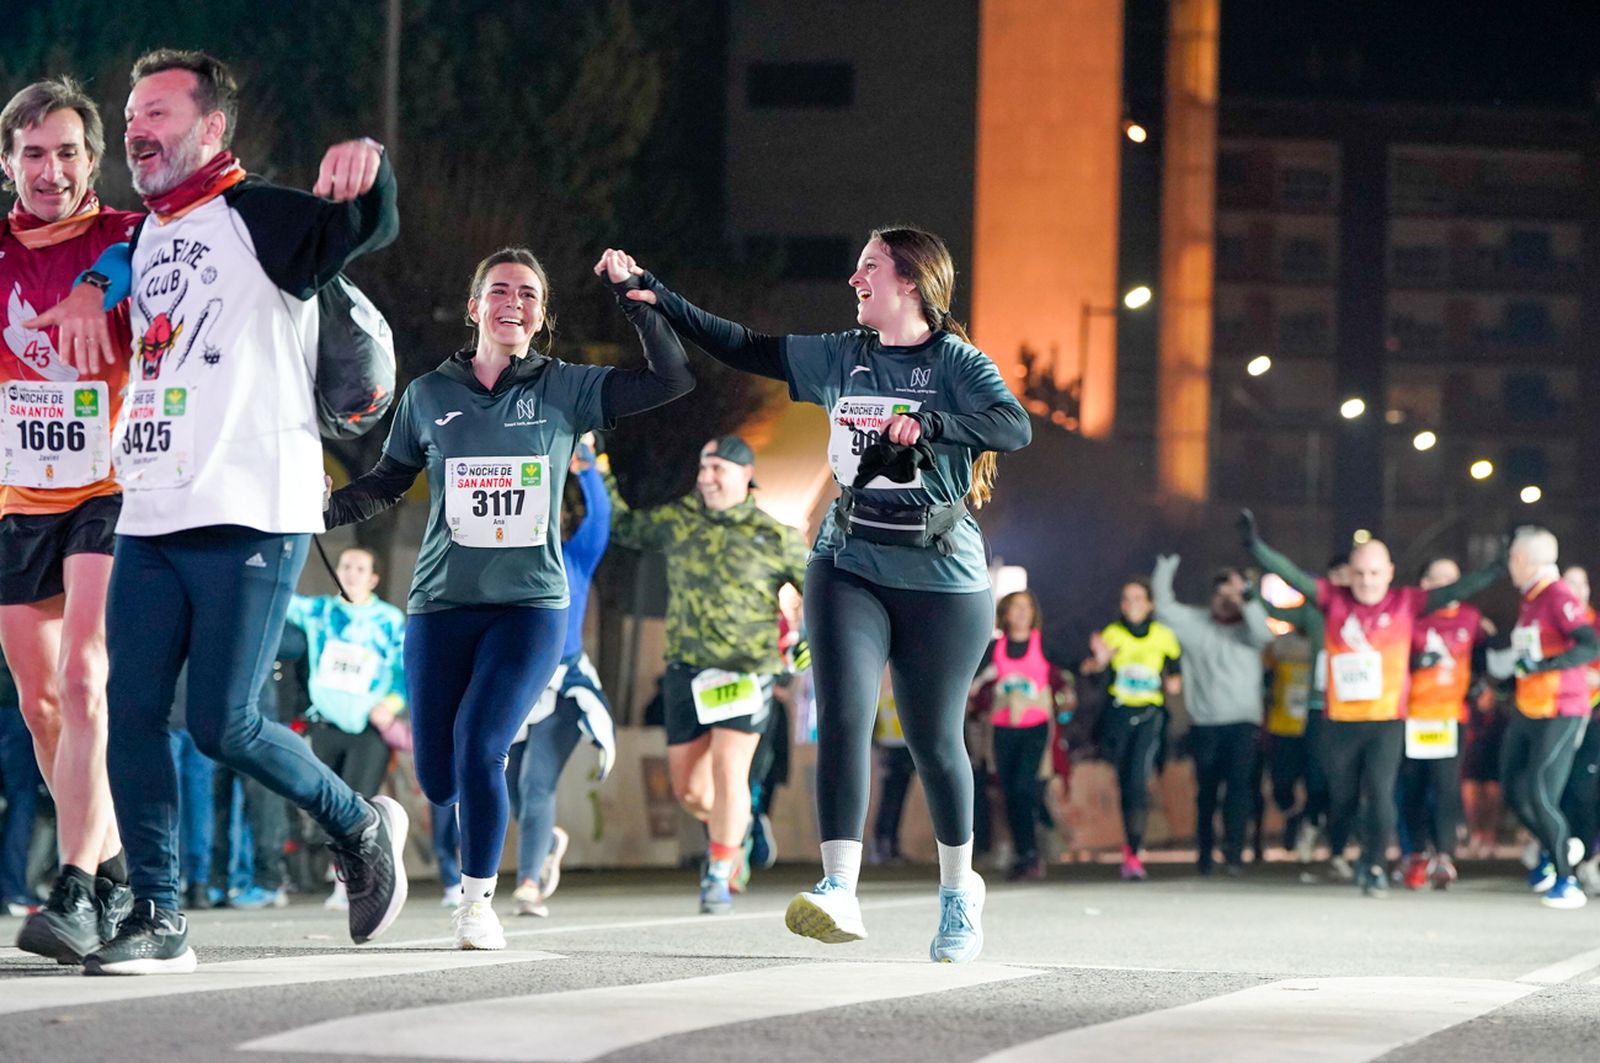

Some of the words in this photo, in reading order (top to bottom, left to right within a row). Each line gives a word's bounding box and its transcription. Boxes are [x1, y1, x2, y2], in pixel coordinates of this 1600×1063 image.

[146, 268, 181, 299] CLUB
[24, 340, 50, 368] 43
[20, 394, 48, 404] NOCHE
[51, 394, 64, 404] DE
[9, 405, 26, 417] SAN
[28, 405, 64, 418] ANTÓN
[849, 406, 873, 416] NOCHE
[873, 406, 884, 416] DE
[17, 419, 86, 452] 1666
[122, 420, 172, 455] 3425
[851, 429, 882, 456] 90
[469, 467, 499, 477] NOCHE
[500, 466, 512, 476] DE
[457, 479, 477, 489] SAN
[479, 475, 513, 488] ANTÓN
[472, 489, 526, 518] 3117
[493, 518, 506, 526] Ana
